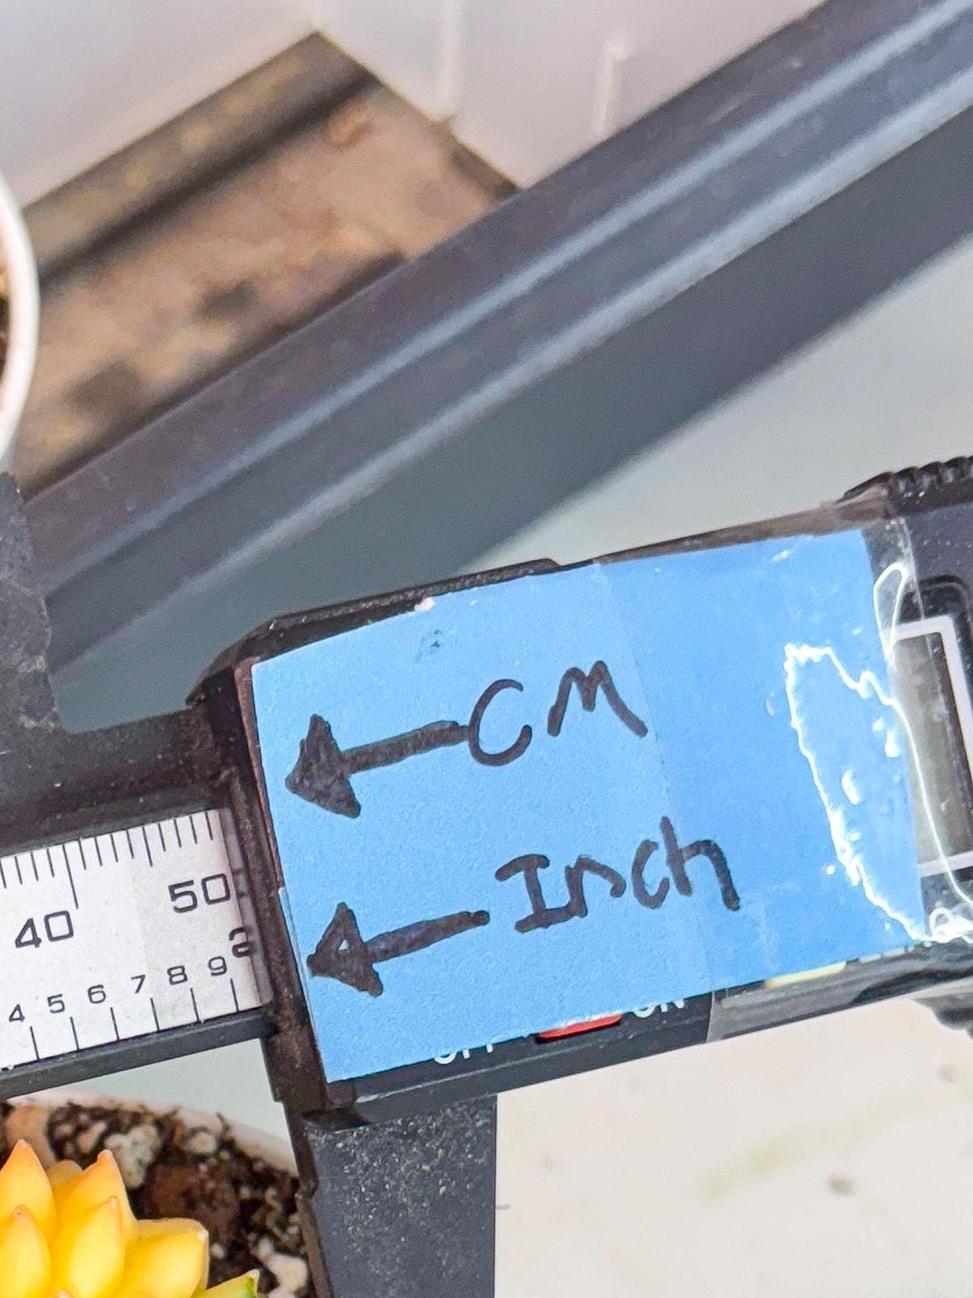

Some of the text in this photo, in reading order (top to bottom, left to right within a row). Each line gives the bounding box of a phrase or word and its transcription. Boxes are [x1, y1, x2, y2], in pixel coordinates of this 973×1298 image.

[14, 910, 74, 949] 40
[168, 873, 231, 913] 50
[495, 816, 741, 932] Inch
[8, 1004, 25, 1023] 4
[47, 994, 66, 1013] 5
[87, 985, 107, 1004] 6
[130, 975, 147, 993] 7
[167, 965, 188, 986] 8
[208, 956, 227, 976] 9
